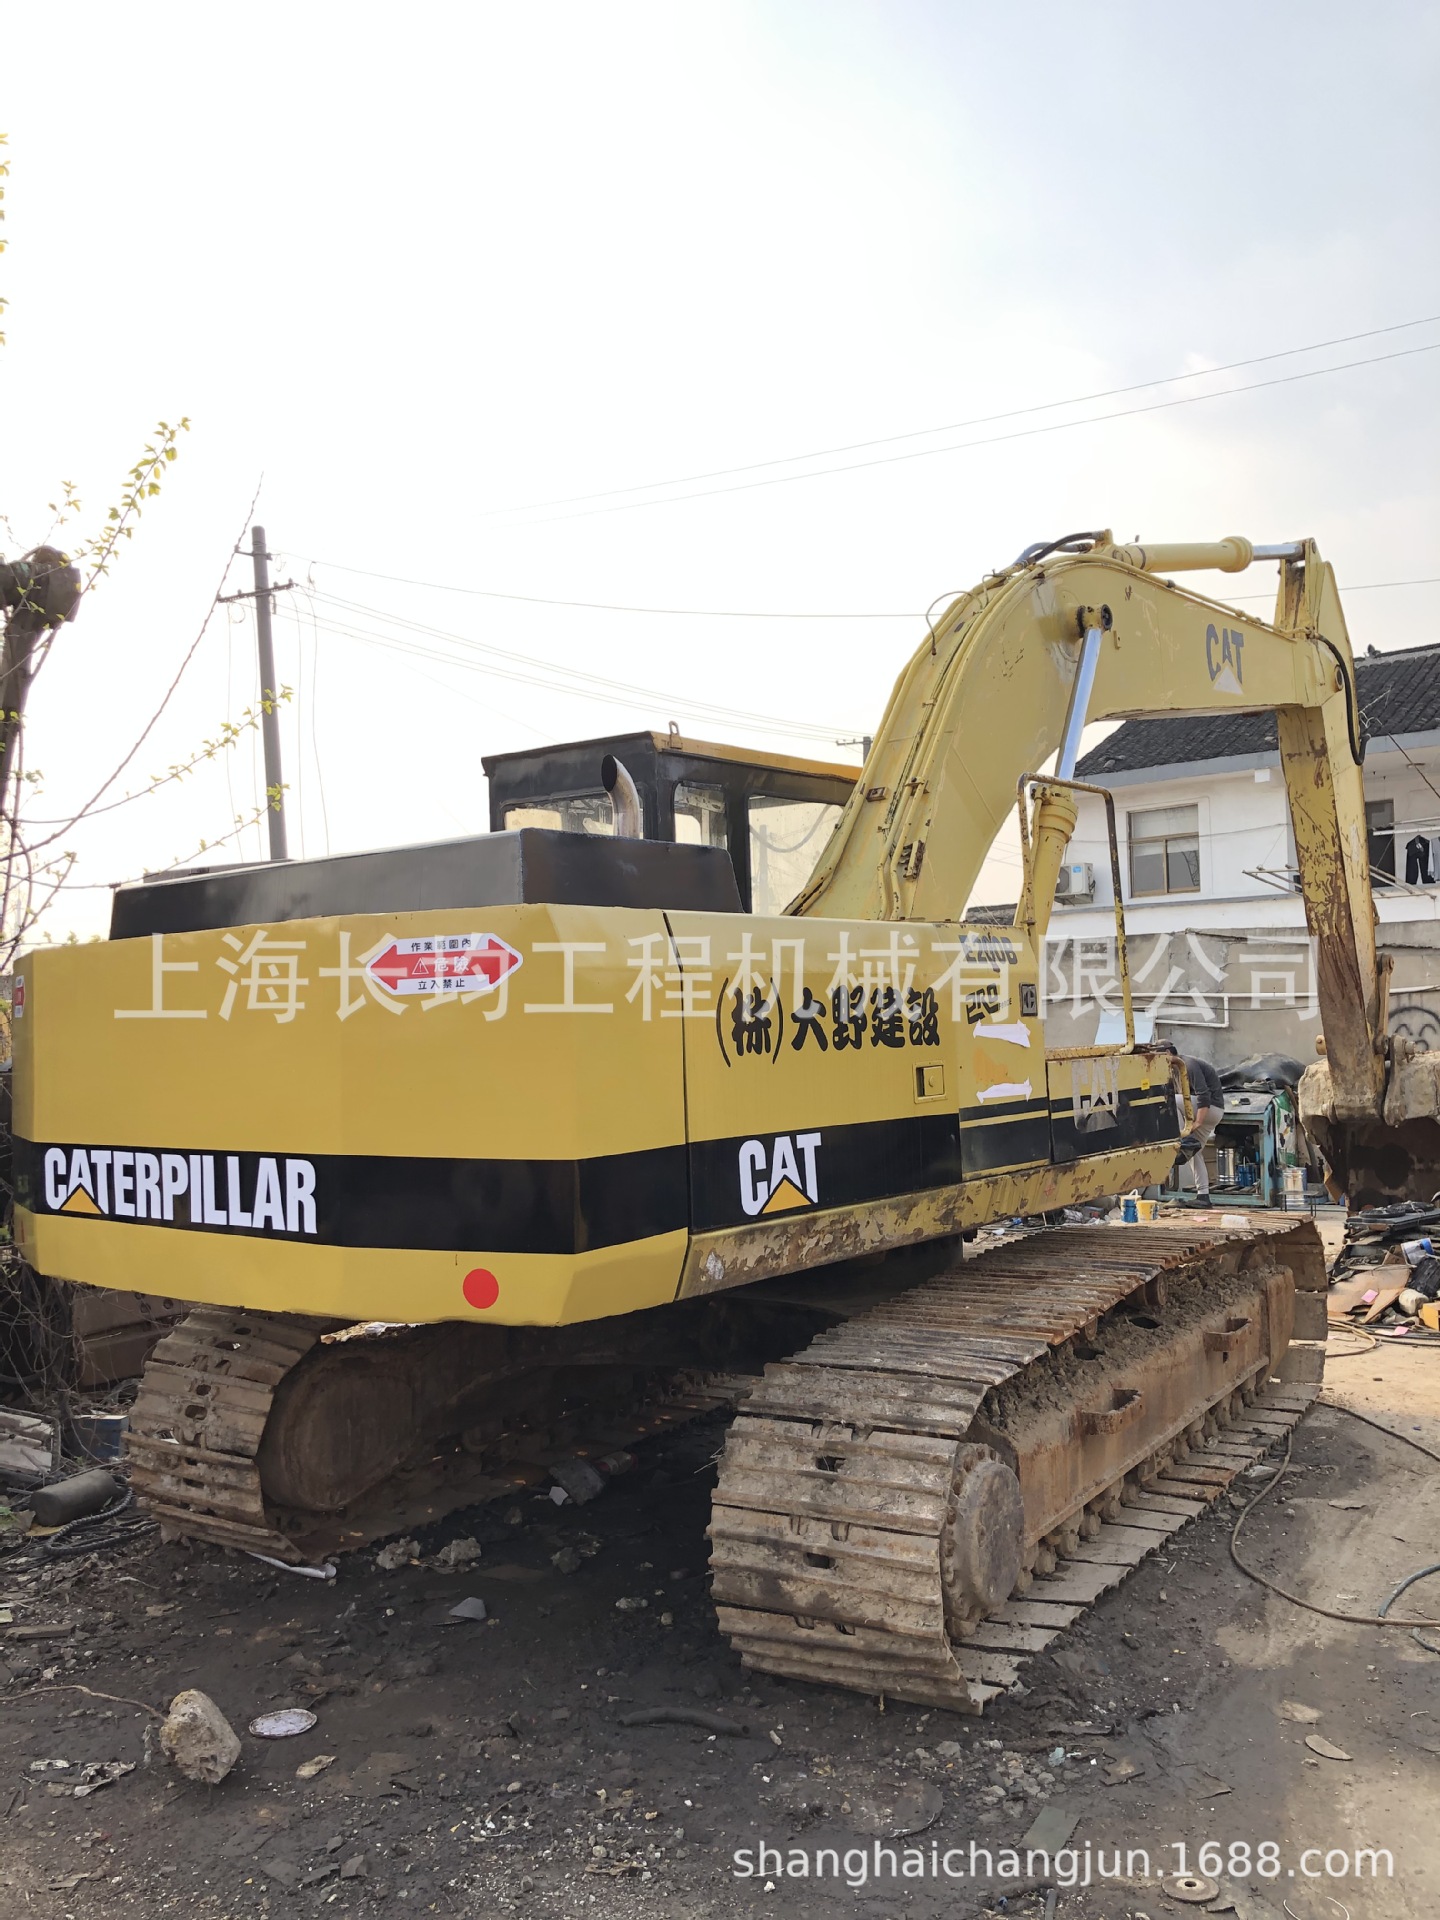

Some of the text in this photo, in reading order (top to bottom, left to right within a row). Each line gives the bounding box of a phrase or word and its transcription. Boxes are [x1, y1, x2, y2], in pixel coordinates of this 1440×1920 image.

[1206, 624, 1244, 685] CAT
[418, 978, 465, 990] 立入禁止
[44, 1147, 318, 1235] CATERPILLAR
[739, 1132, 821, 1216] CAT
